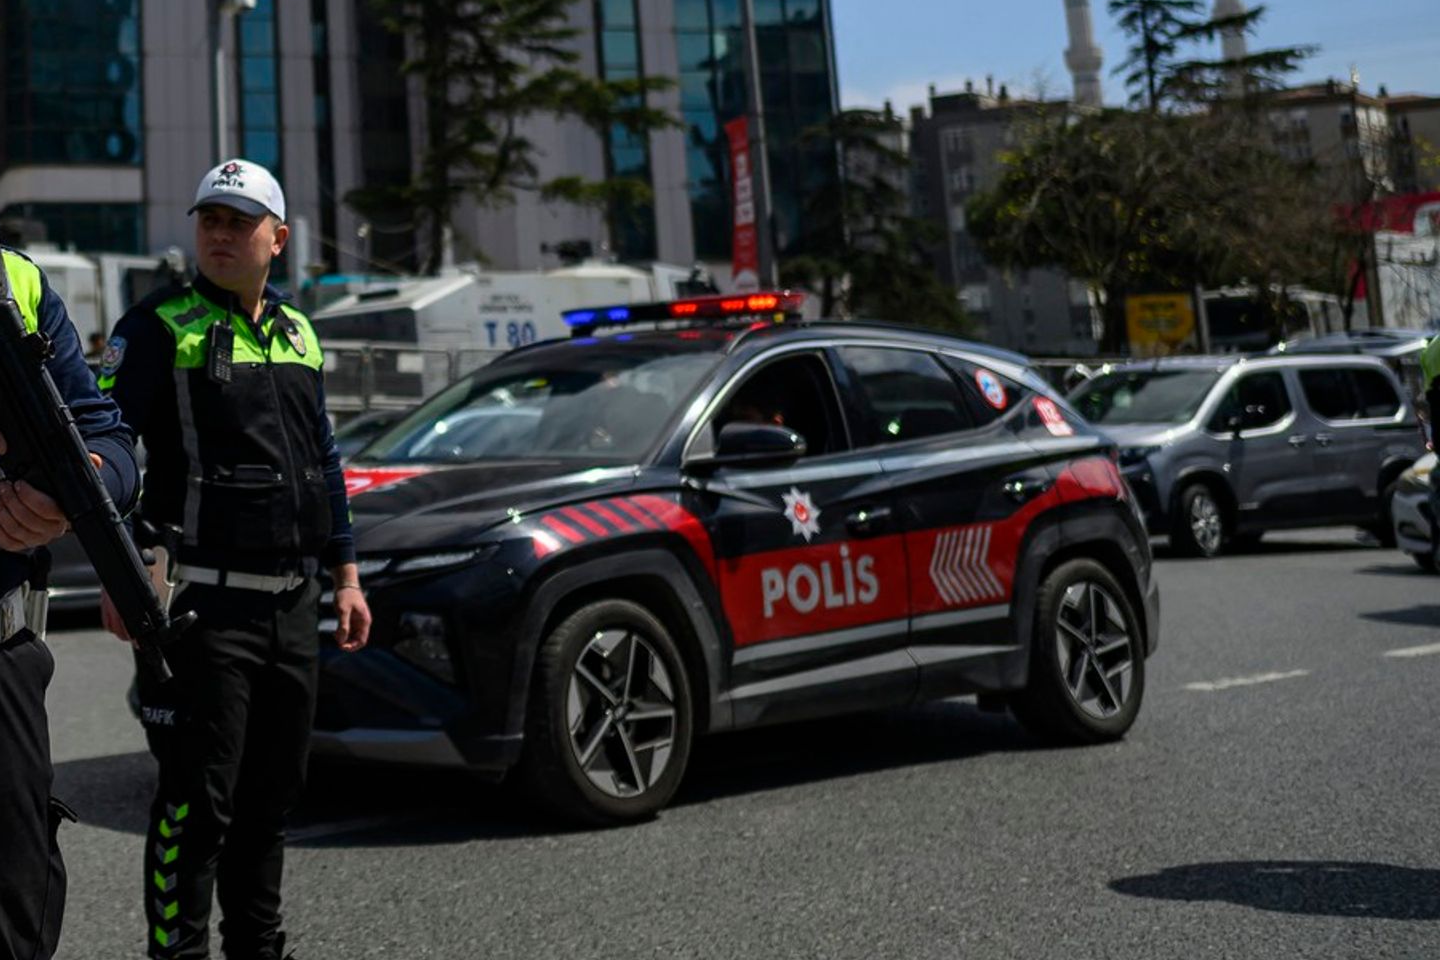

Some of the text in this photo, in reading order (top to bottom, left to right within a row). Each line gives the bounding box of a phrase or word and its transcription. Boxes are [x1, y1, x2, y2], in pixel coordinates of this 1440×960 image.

[483, 321, 537, 349] T 80
[761, 543, 880, 618] POLİS
